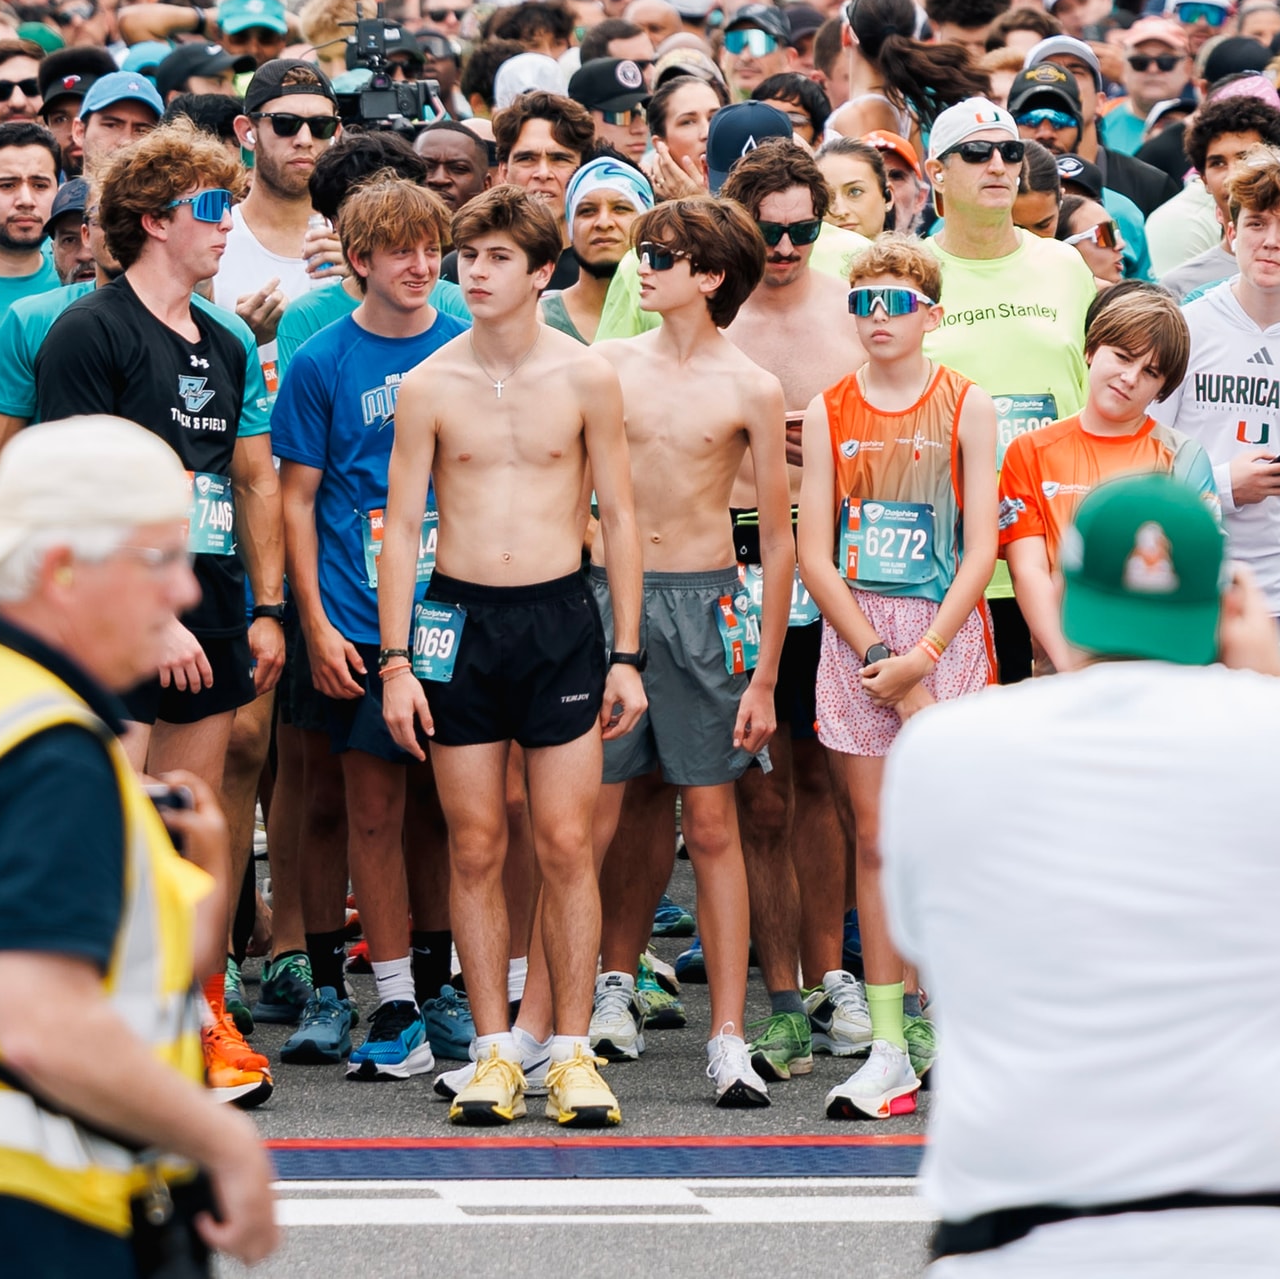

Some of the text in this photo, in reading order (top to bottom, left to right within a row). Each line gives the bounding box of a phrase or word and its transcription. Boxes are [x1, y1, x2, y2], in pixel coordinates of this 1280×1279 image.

[997, 303, 1058, 322] Stanley
[198, 499, 233, 532] 7446
[849, 506, 860, 518] 5K
[865, 526, 927, 560] 6272
[849, 556, 856, 567] A
